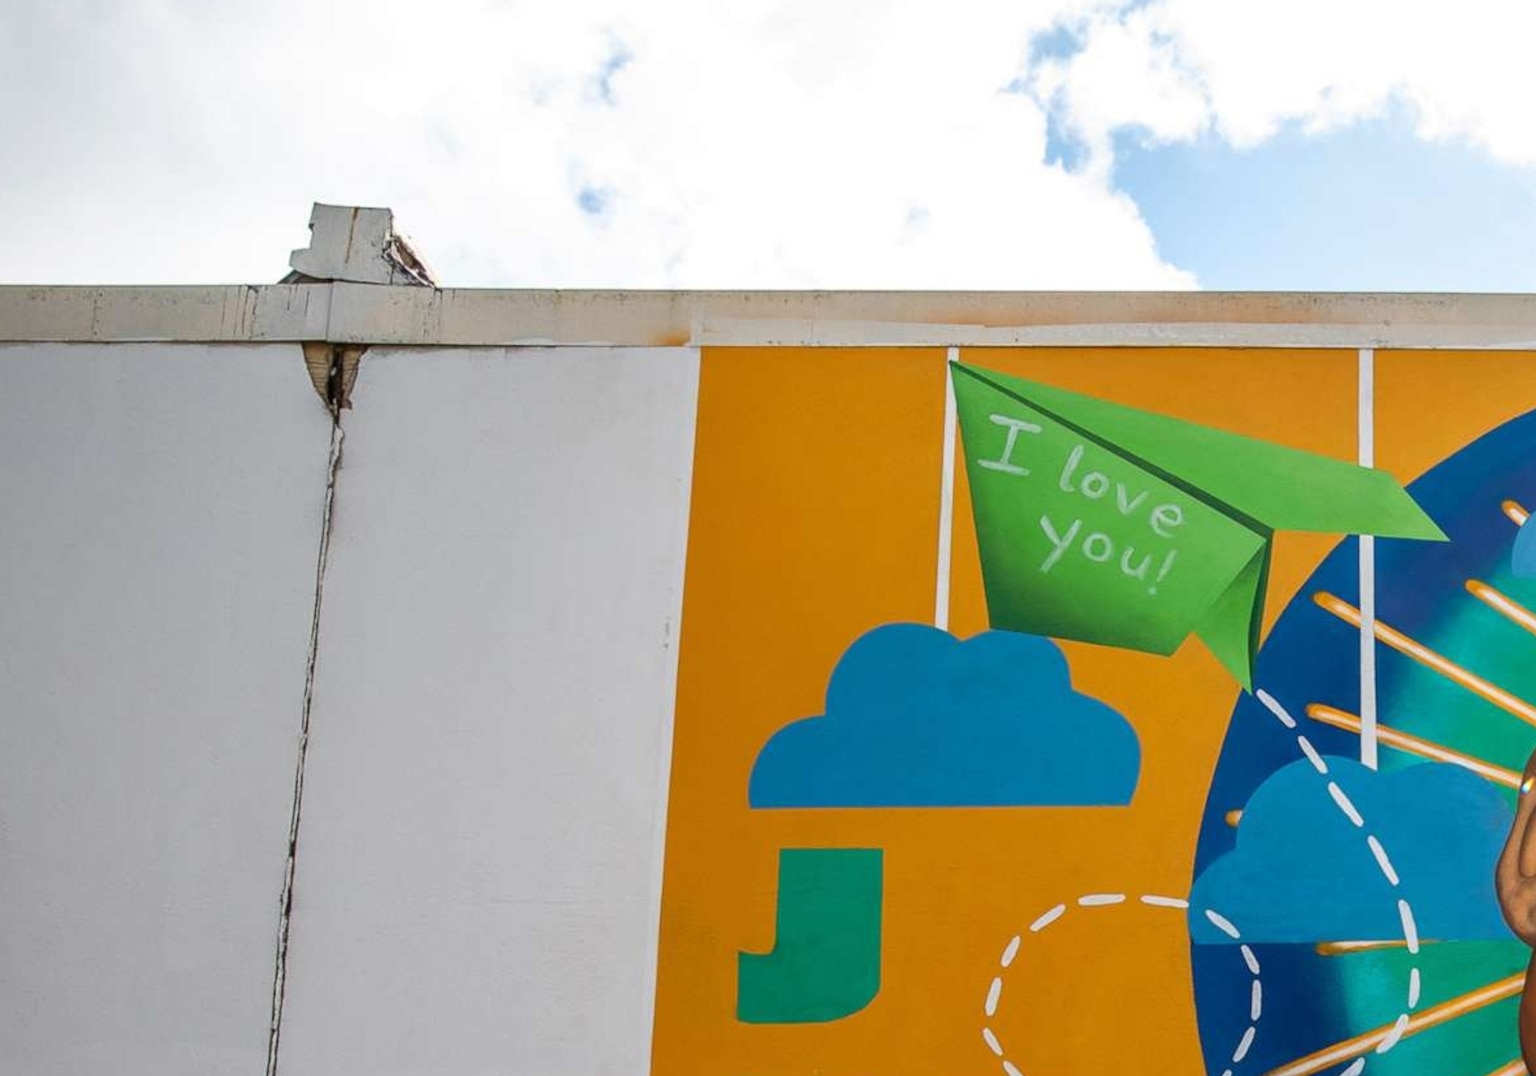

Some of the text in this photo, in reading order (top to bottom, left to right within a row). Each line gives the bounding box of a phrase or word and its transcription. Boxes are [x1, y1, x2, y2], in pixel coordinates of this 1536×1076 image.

[977, 413, 1186, 538] I love
[1039, 514, 1178, 596] you!
